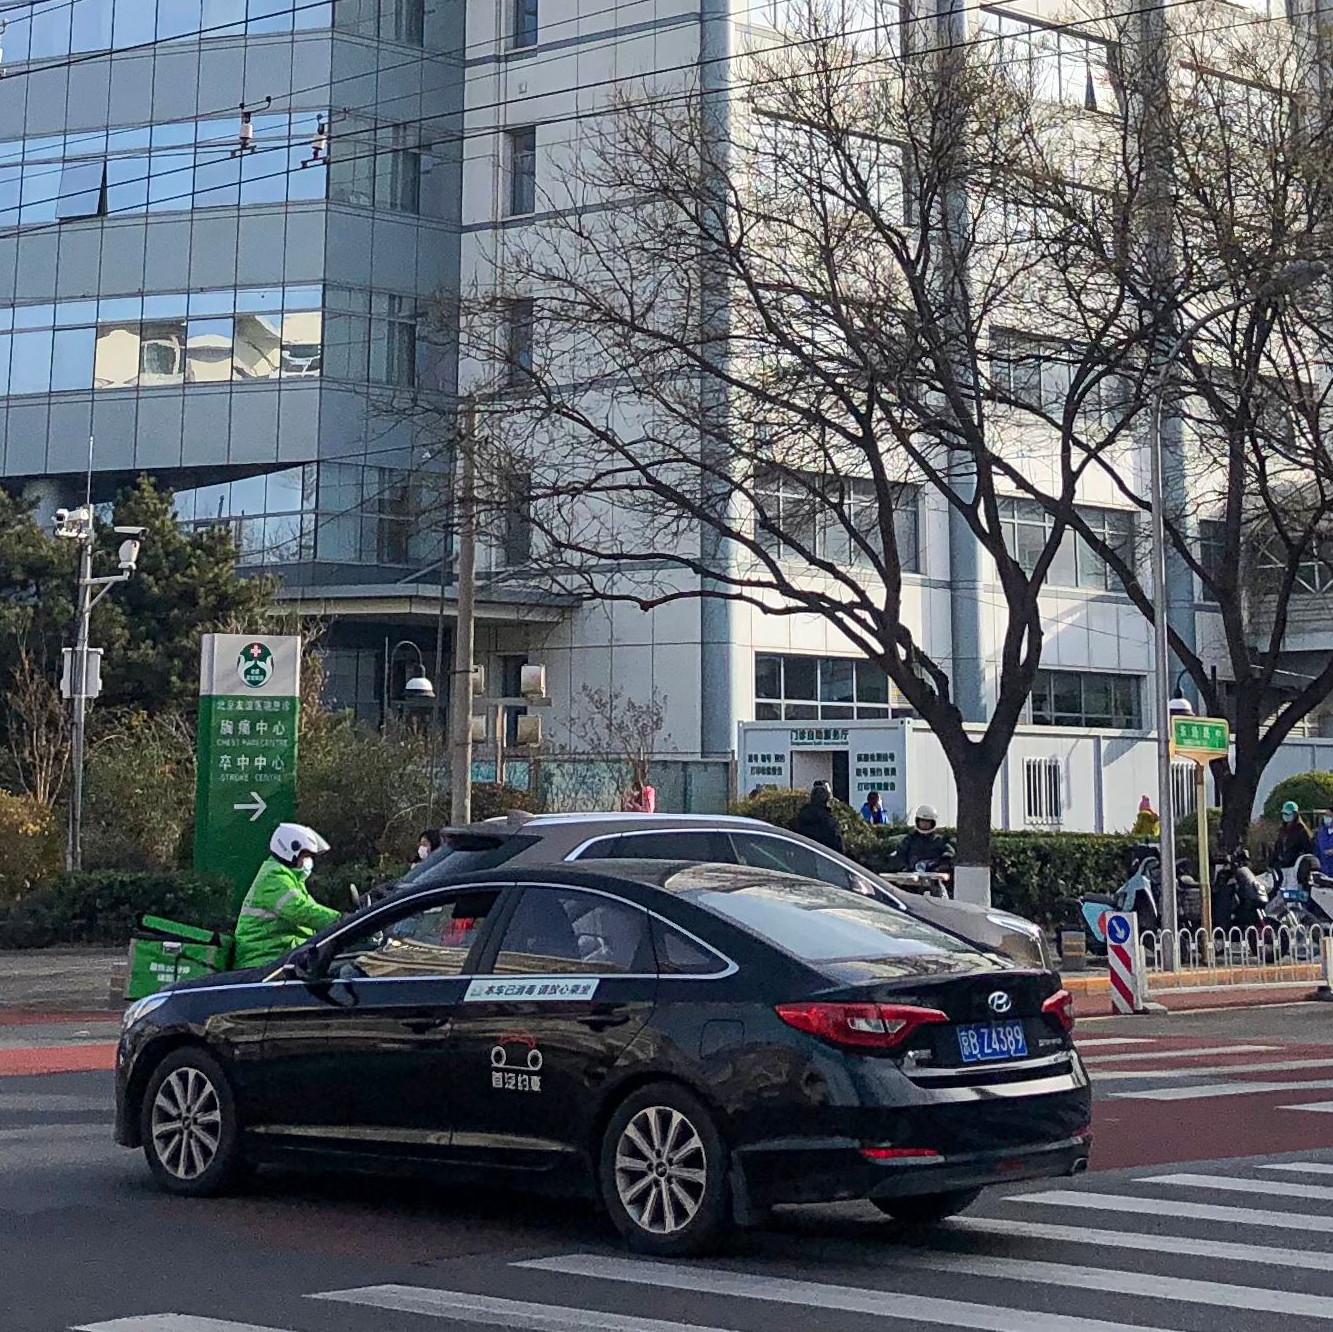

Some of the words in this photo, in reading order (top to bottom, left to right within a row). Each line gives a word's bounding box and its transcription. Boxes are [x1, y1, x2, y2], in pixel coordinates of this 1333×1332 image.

[220, 720, 286, 736] 胸痛中心
[219, 754, 285, 771] 卒中中心
[484, 984, 536, 996] 本车已消毒
[537, 984, 592, 996] 请放心乘坐
